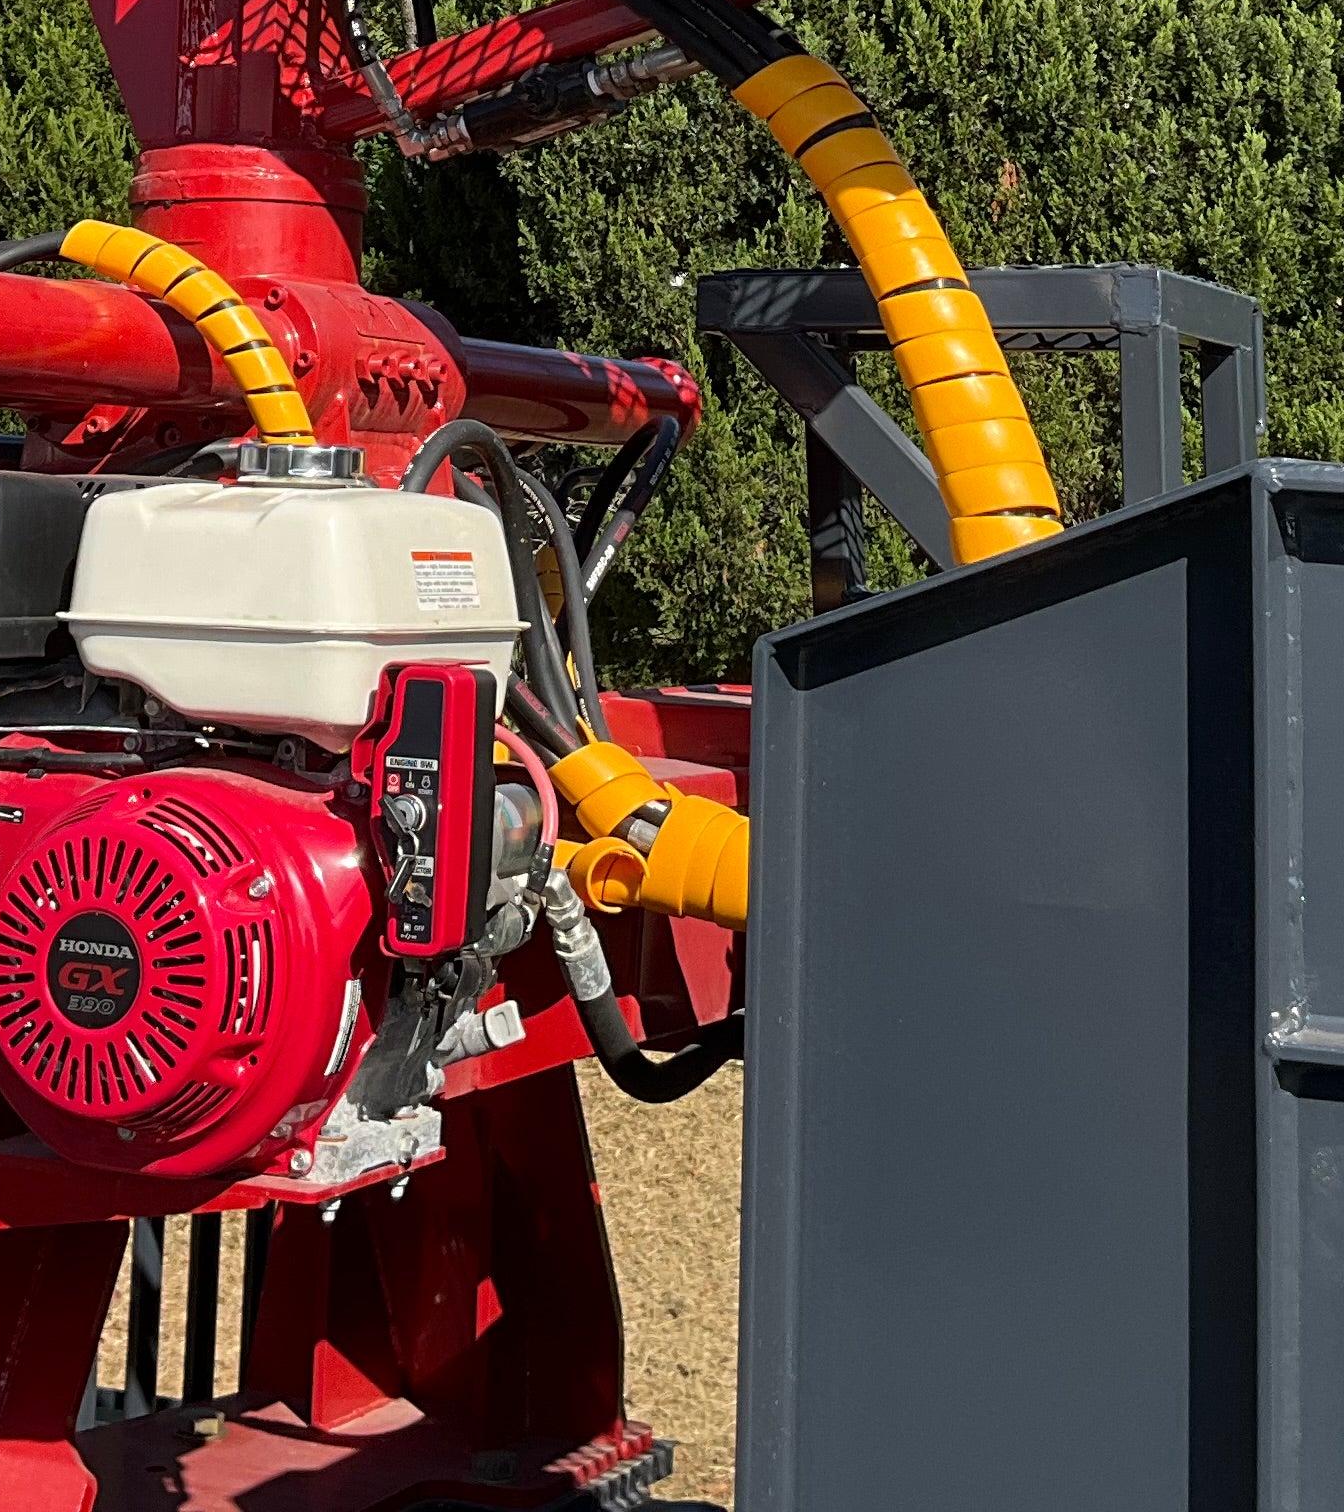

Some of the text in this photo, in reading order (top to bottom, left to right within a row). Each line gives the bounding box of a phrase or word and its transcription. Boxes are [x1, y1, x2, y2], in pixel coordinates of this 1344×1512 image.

[59, 938, 134, 959] HONDA
[59, 961, 130, 996] GX
[67, 994, 116, 1016] 390
